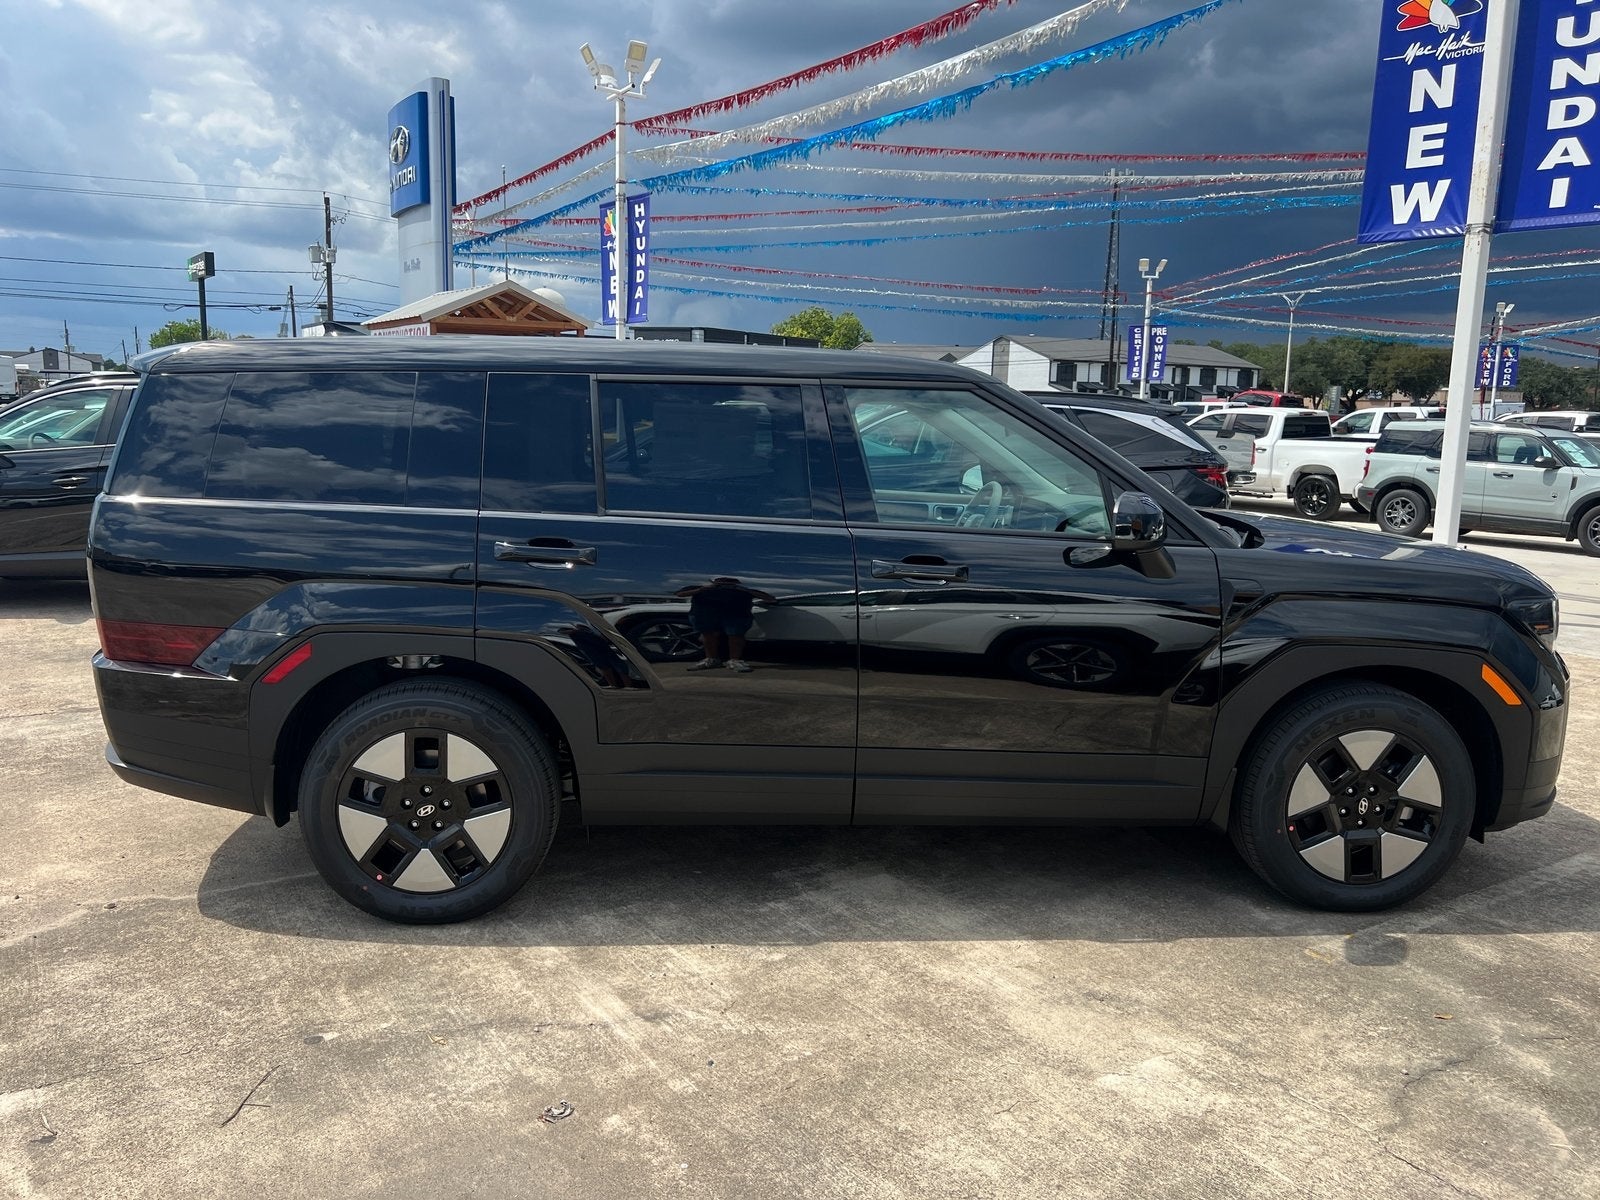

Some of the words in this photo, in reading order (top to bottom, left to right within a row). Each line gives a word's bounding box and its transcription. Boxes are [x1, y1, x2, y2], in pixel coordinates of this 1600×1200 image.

[1403, 42, 1436, 65] Mac
[1435, 31, 1471, 60] Haik
[1536, 0, 1600, 209] UNDAI
[1390, 64, 1457, 225] NEW
[634, 203, 646, 315] HYUNDAI
[1151, 327, 1167, 336] PRE
[1132, 328, 1142, 378] CERTIFIED
[1152, 336, 1164, 378] OWNED
[1480, 361, 1491, 386] NEW
[1502, 361, 1512, 386] FORD
